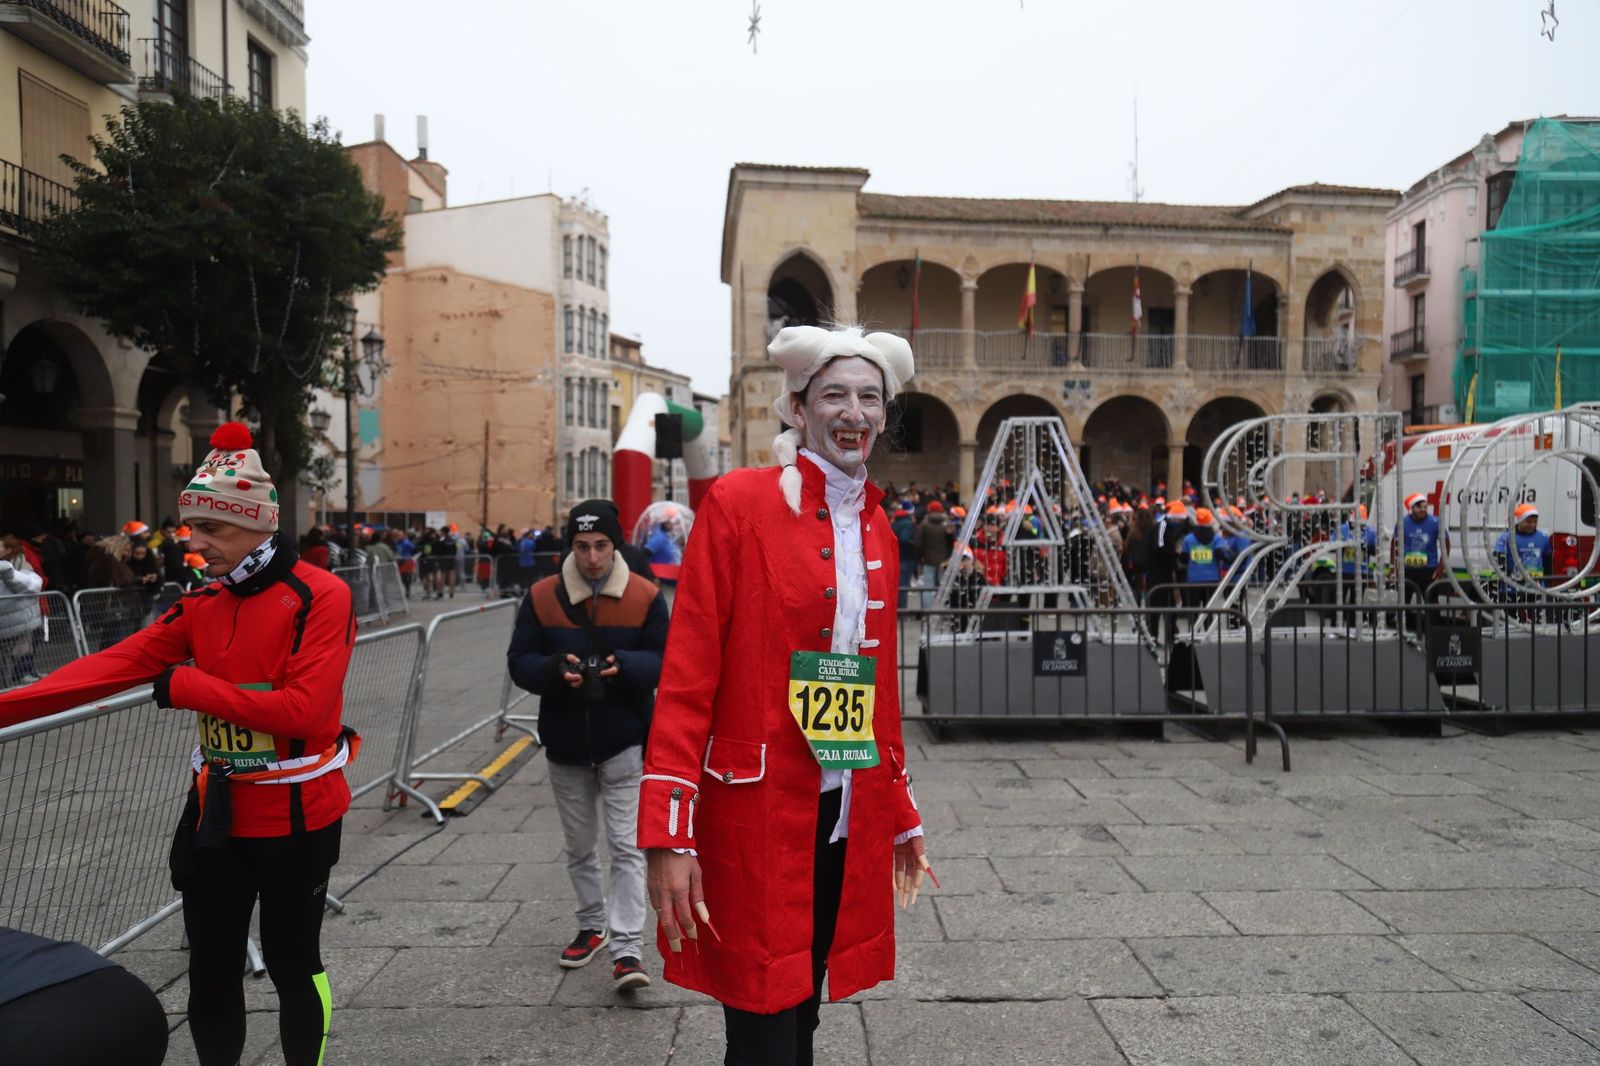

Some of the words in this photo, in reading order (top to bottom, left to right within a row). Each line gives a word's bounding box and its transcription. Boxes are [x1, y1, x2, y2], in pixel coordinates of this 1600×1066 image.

[197, 495, 261, 521] mood
[578, 523, 594, 531] BOY
[818, 666, 837, 676] CAJA
[838, 668, 860, 677] RURAL
[796, 685, 865, 732] 1235
[201, 713, 253, 752] 1315
[842, 749, 873, 761] RURAL
[234, 757, 272, 768] RURAL
